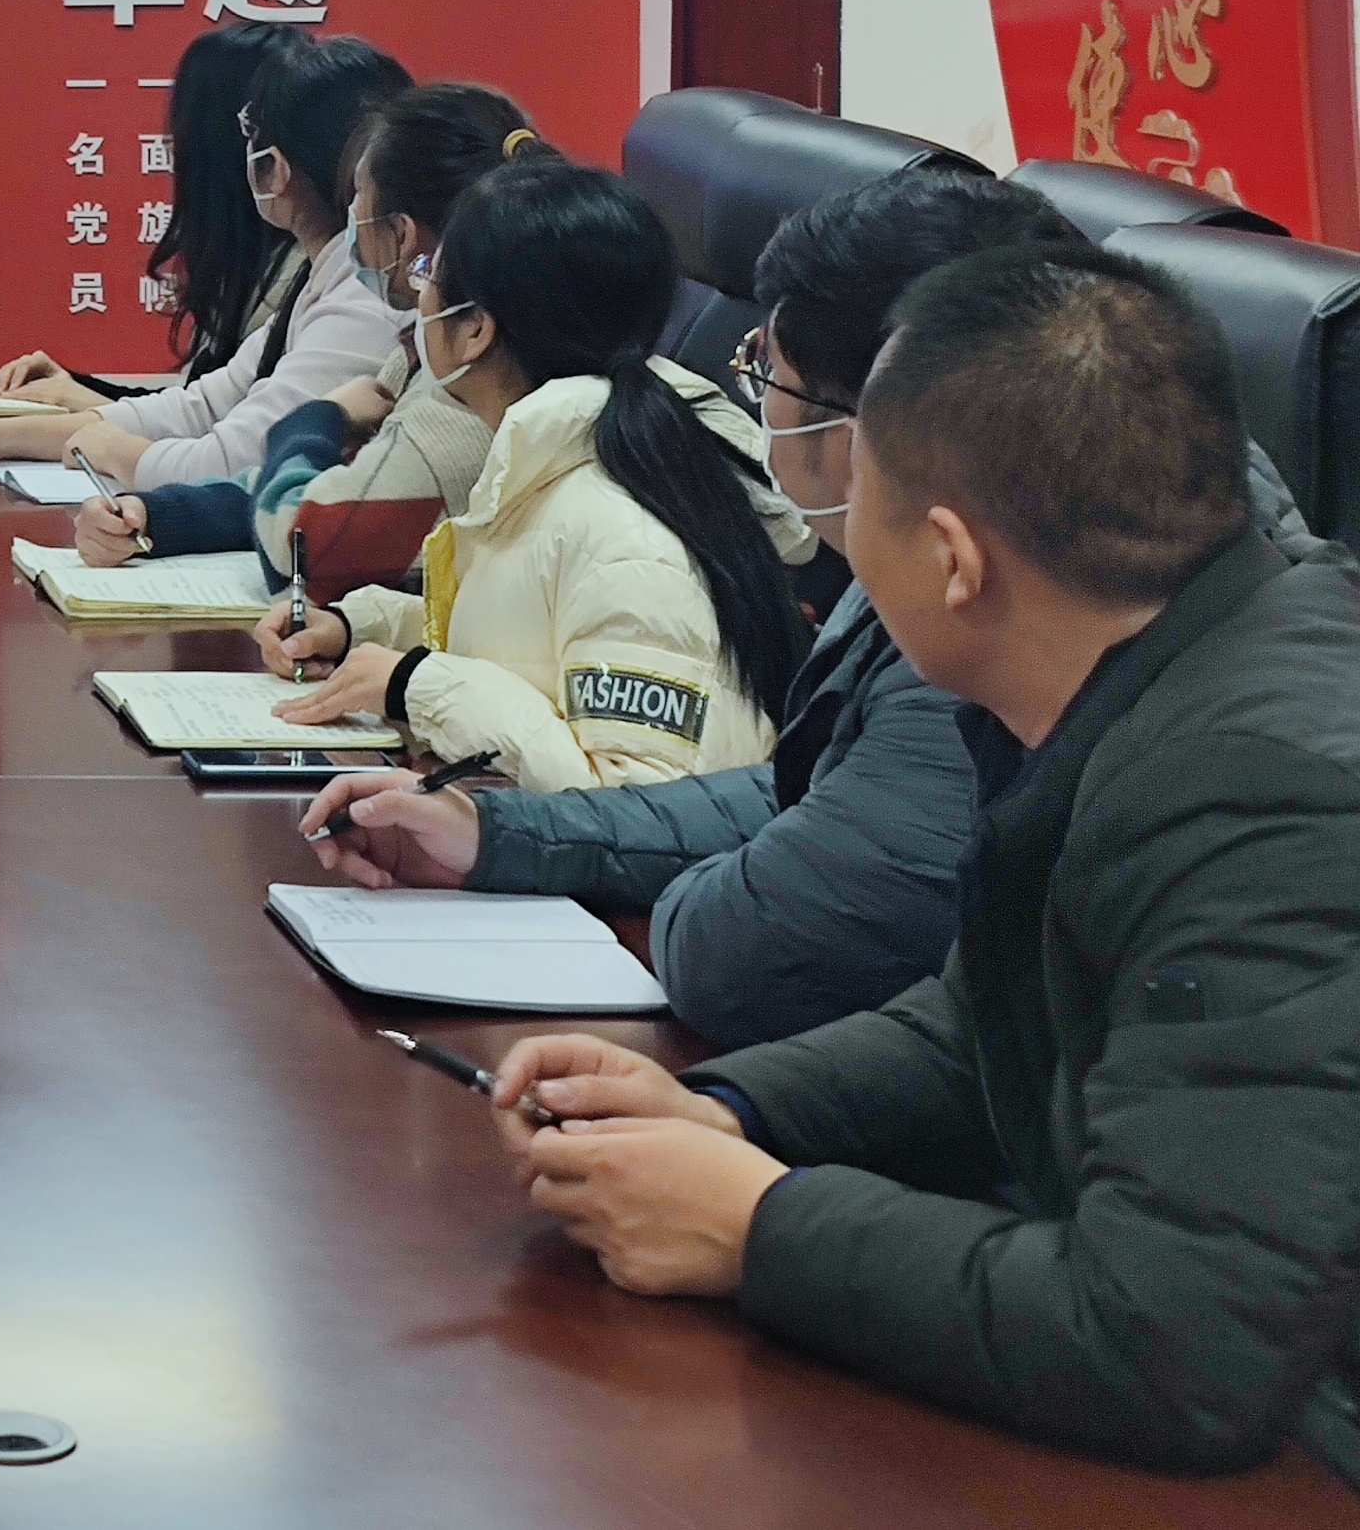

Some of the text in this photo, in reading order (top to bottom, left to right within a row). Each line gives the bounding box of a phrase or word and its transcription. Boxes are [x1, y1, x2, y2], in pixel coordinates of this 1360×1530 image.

[65, 78, 108, 315] 一名党员
[573, 674, 688, 727] FASHION
